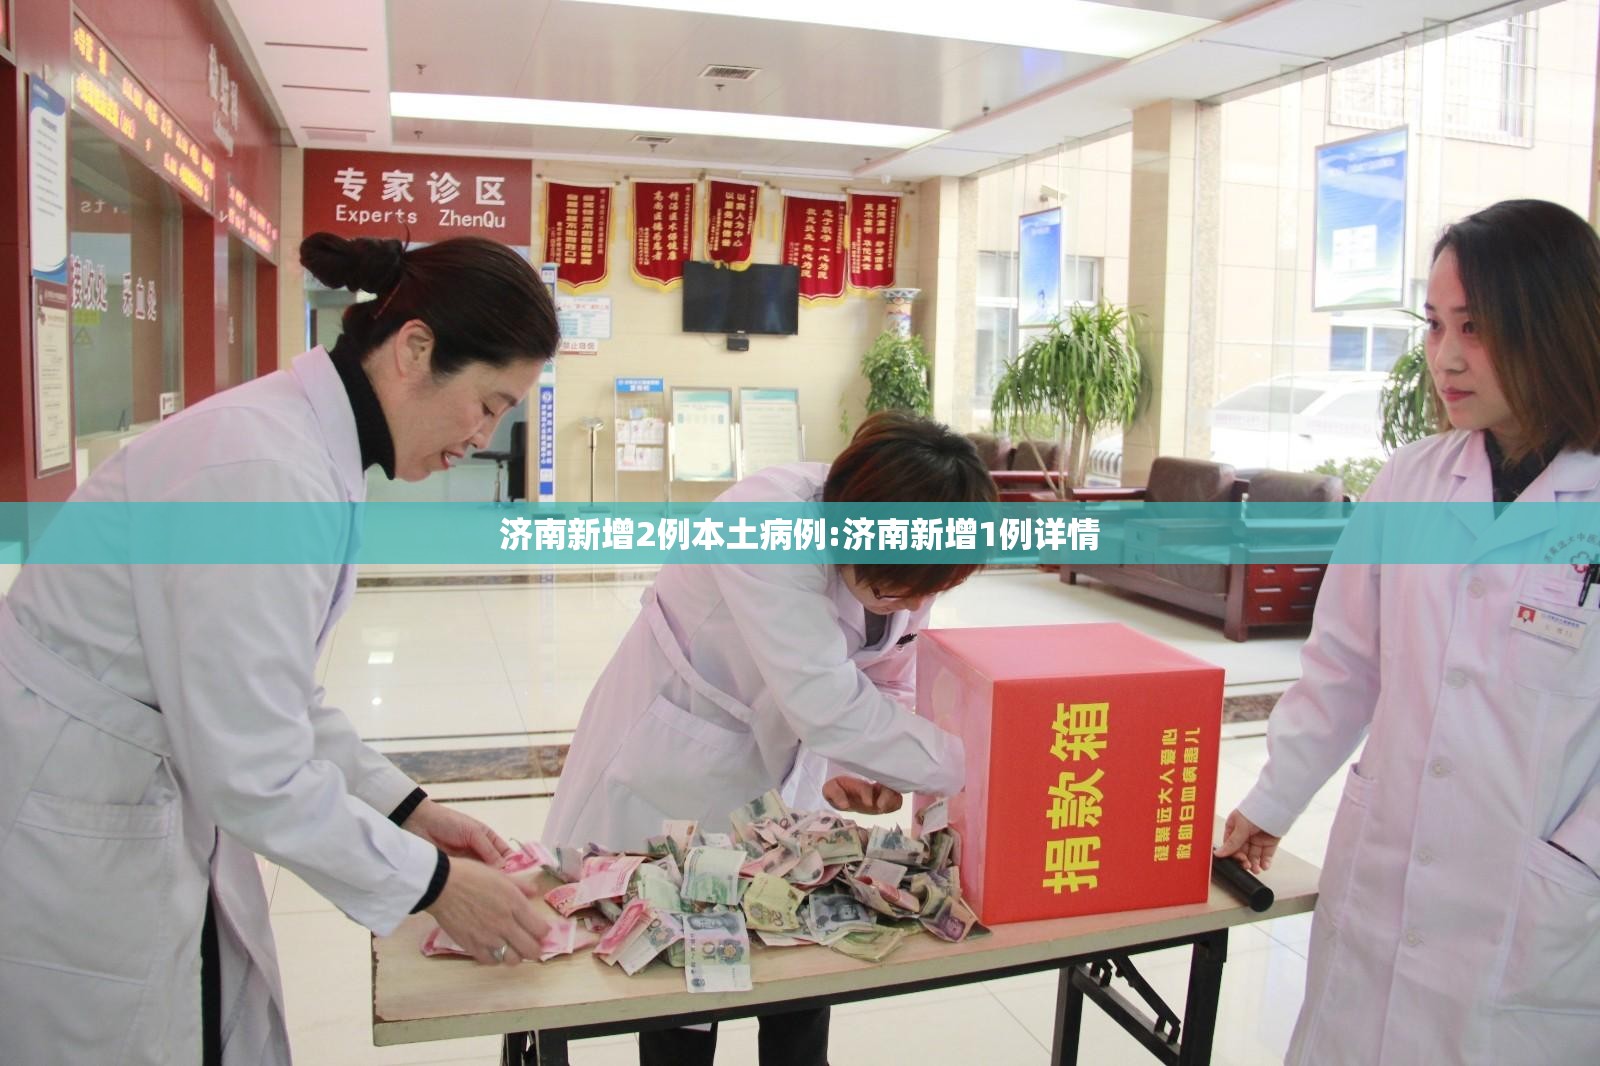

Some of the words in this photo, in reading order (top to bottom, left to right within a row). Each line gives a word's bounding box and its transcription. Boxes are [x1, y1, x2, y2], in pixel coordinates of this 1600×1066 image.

[334, 167, 505, 206] 专家诊区
[336, 204, 418, 224] Experts
[439, 209, 505, 228] ZhenQu
[1042, 702, 1110, 894] 捐款箱
[1176, 727, 1201, 860] 救助白血病患儿
